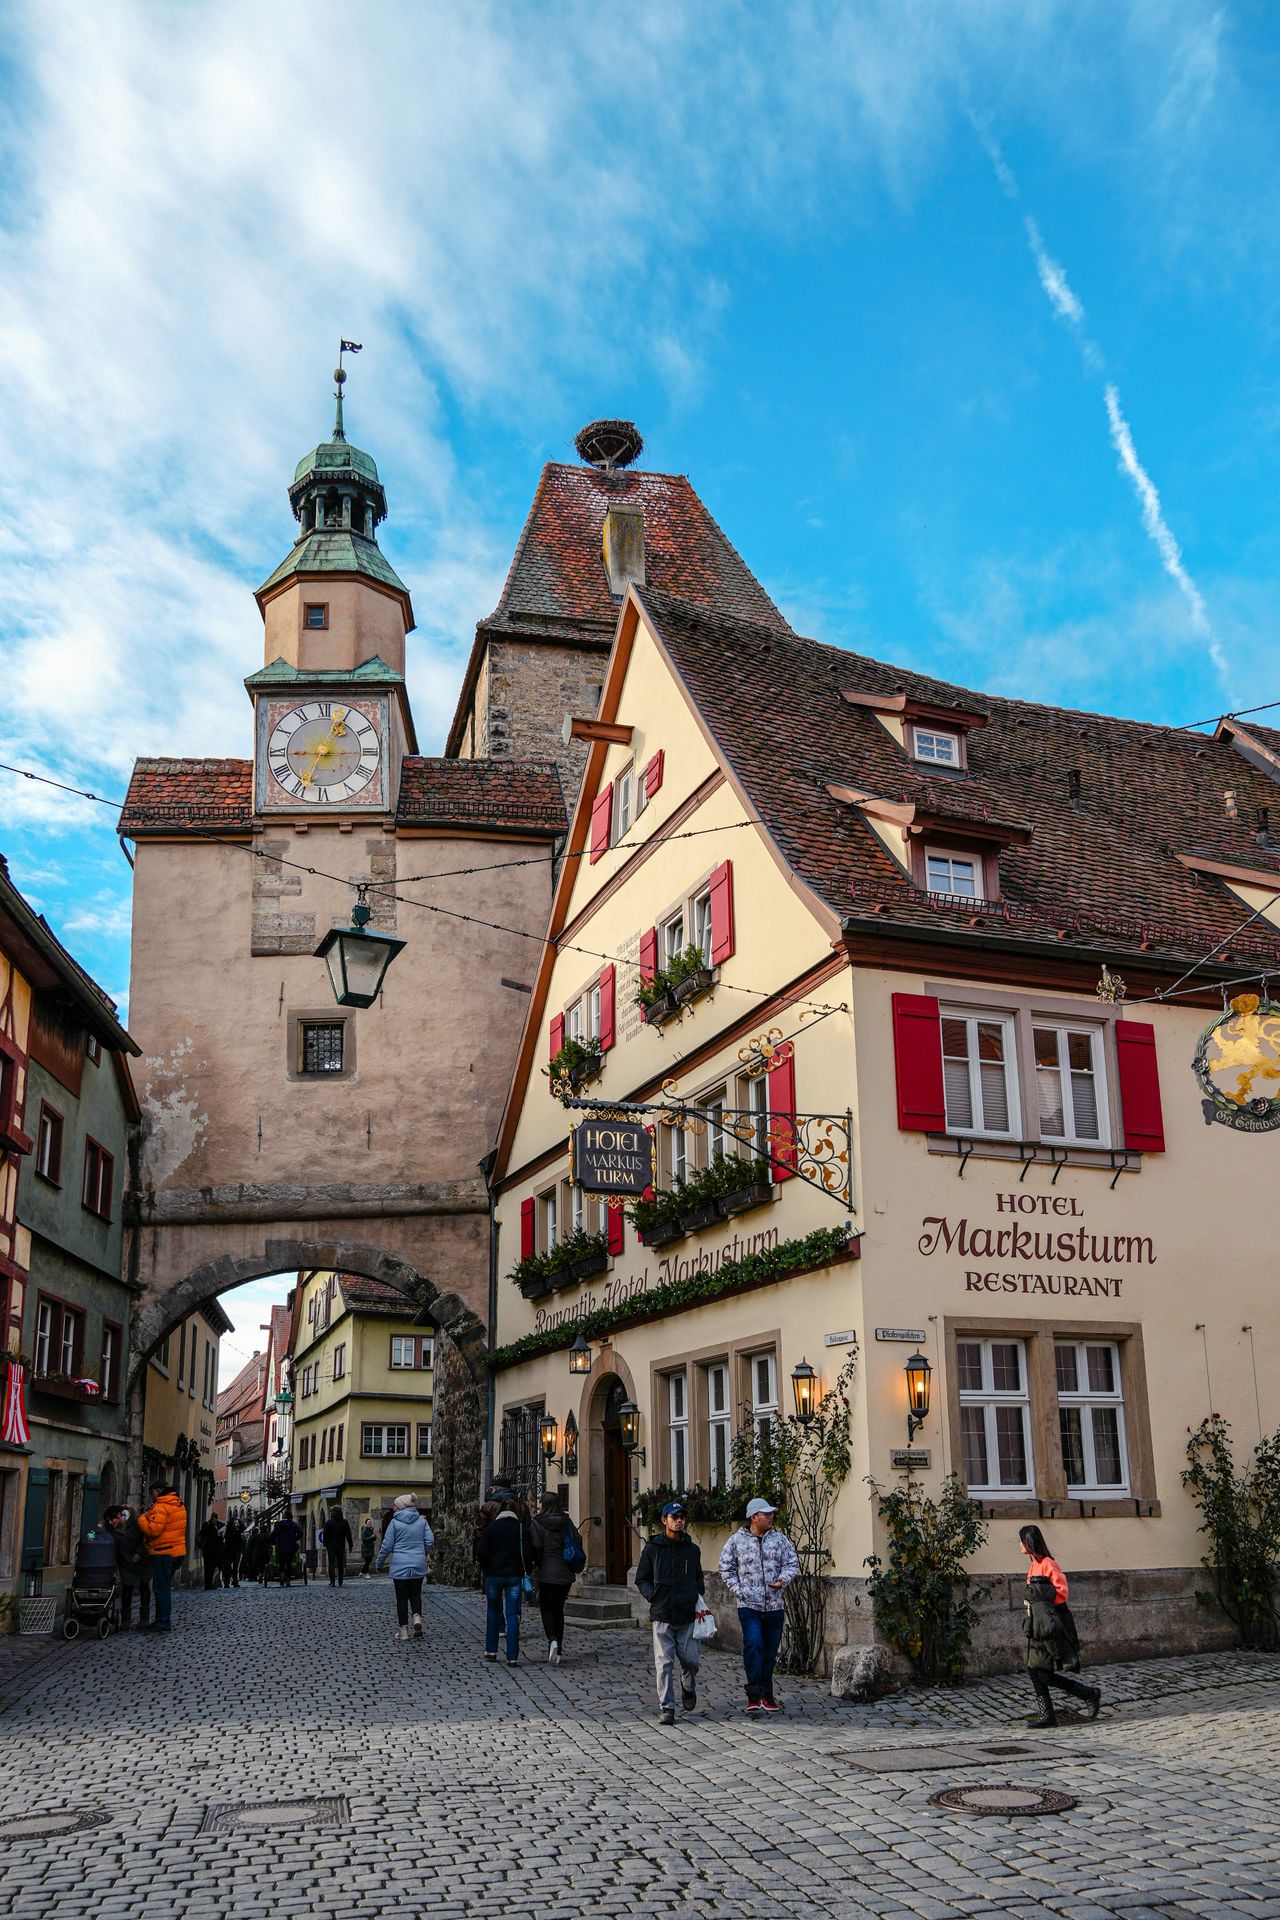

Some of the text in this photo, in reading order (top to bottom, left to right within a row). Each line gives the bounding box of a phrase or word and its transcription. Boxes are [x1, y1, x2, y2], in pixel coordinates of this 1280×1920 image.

[1235, 1112, 1280, 1132] Scheiben
[586, 1130, 641, 1152] HOTEL
[585, 1154, 644, 1170] MARKUS
[594, 1169, 635, 1185] TURM
[995, 1193, 1084, 1217] HOTEL
[918, 1216, 1157, 1264] Markusturm
[602, 1268, 648, 1310] Hotel
[964, 1271, 1123, 1297] RESTAURANT
